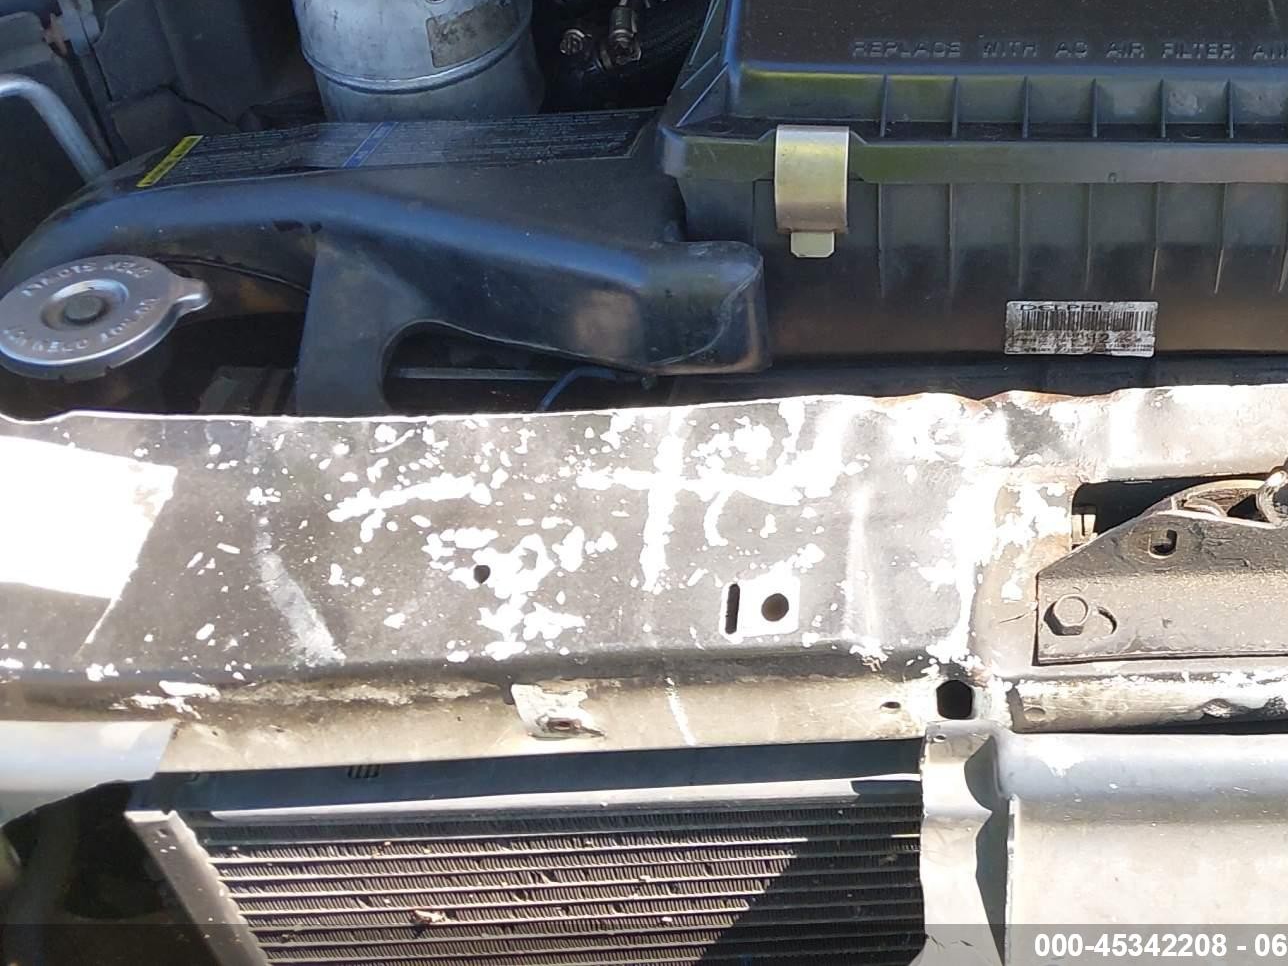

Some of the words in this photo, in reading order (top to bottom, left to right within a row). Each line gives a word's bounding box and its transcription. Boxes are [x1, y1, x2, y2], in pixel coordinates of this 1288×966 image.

[852, 40, 961, 59] REPLACE
[983, 40, 1038, 59] WITH
[1106, 41, 1145, 60] AIR
[1162, 41, 1236, 60] FILTER
